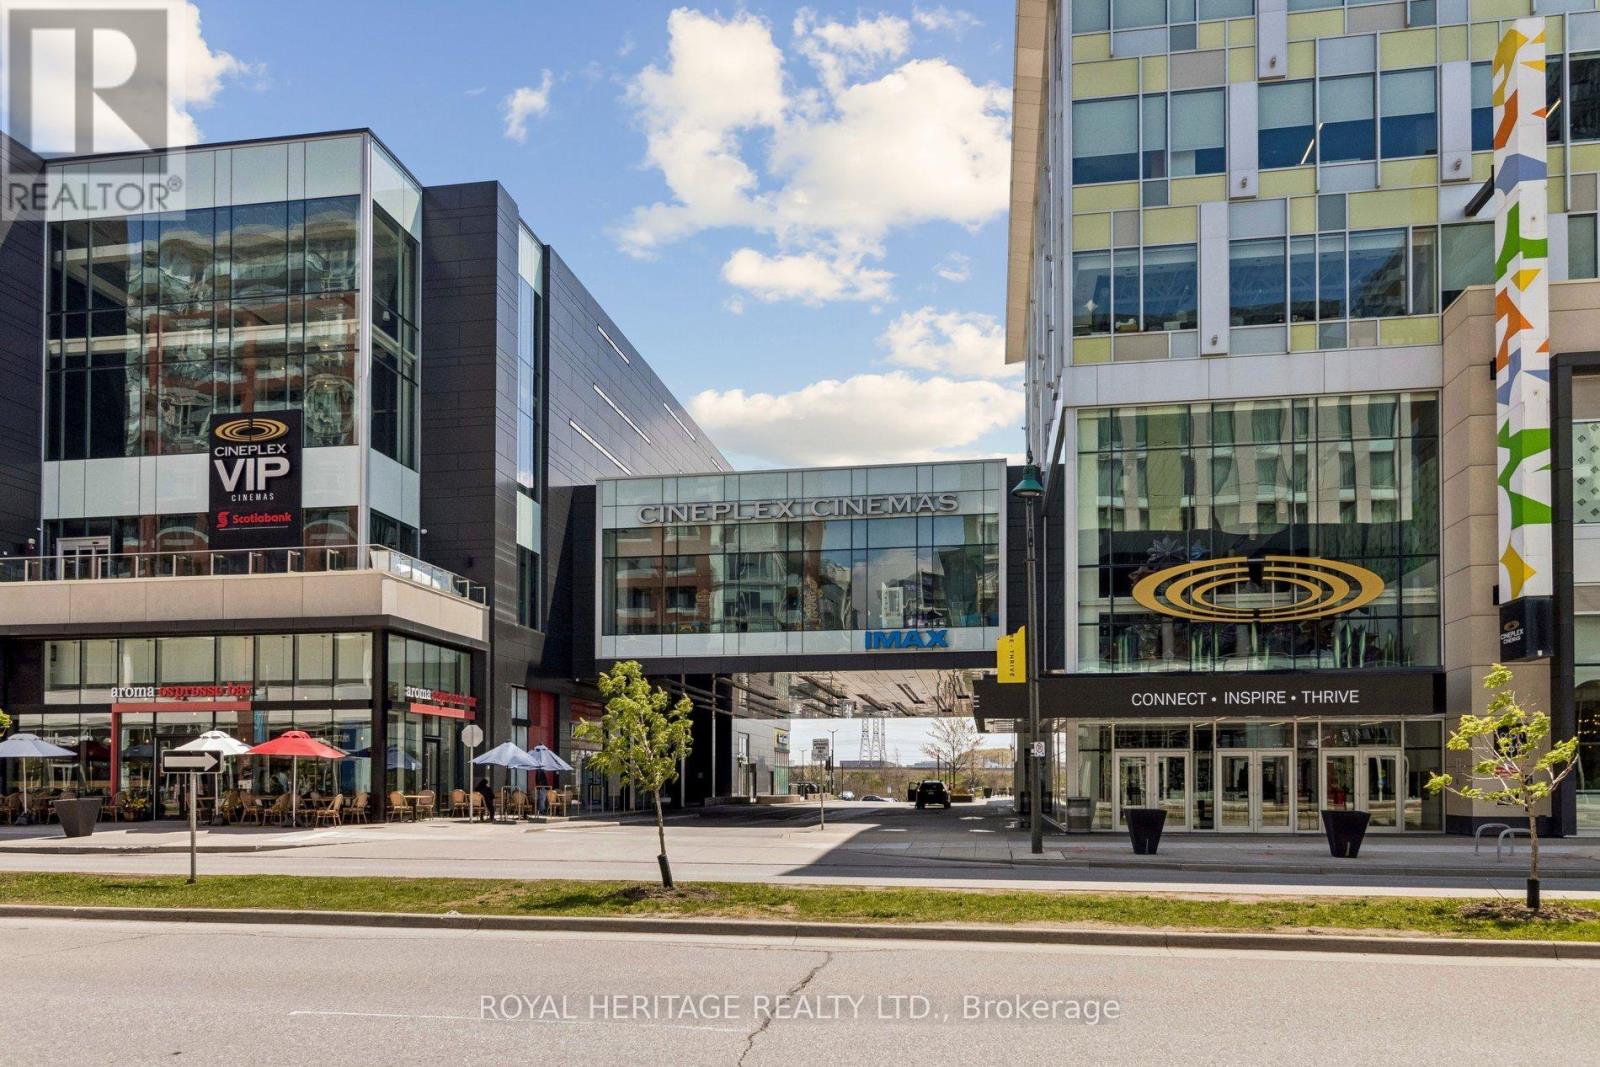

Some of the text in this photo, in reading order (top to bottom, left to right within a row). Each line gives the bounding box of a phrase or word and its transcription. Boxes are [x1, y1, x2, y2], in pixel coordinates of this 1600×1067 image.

[214, 443, 287, 457] CINEPLEX
[213, 456, 290, 493] VIP
[231, 492, 275, 502] CINEMAS
[638, 492, 959, 524] CINEPLEX CINEMAS
[232, 512, 292, 524] Scotiabank
[865, 629, 950, 650] IMAX
[111, 686, 154, 698] aroma
[406, 686, 432, 700] aroma
[1131, 690, 1360, 706] CONNECT INSPIRE THRIVE
